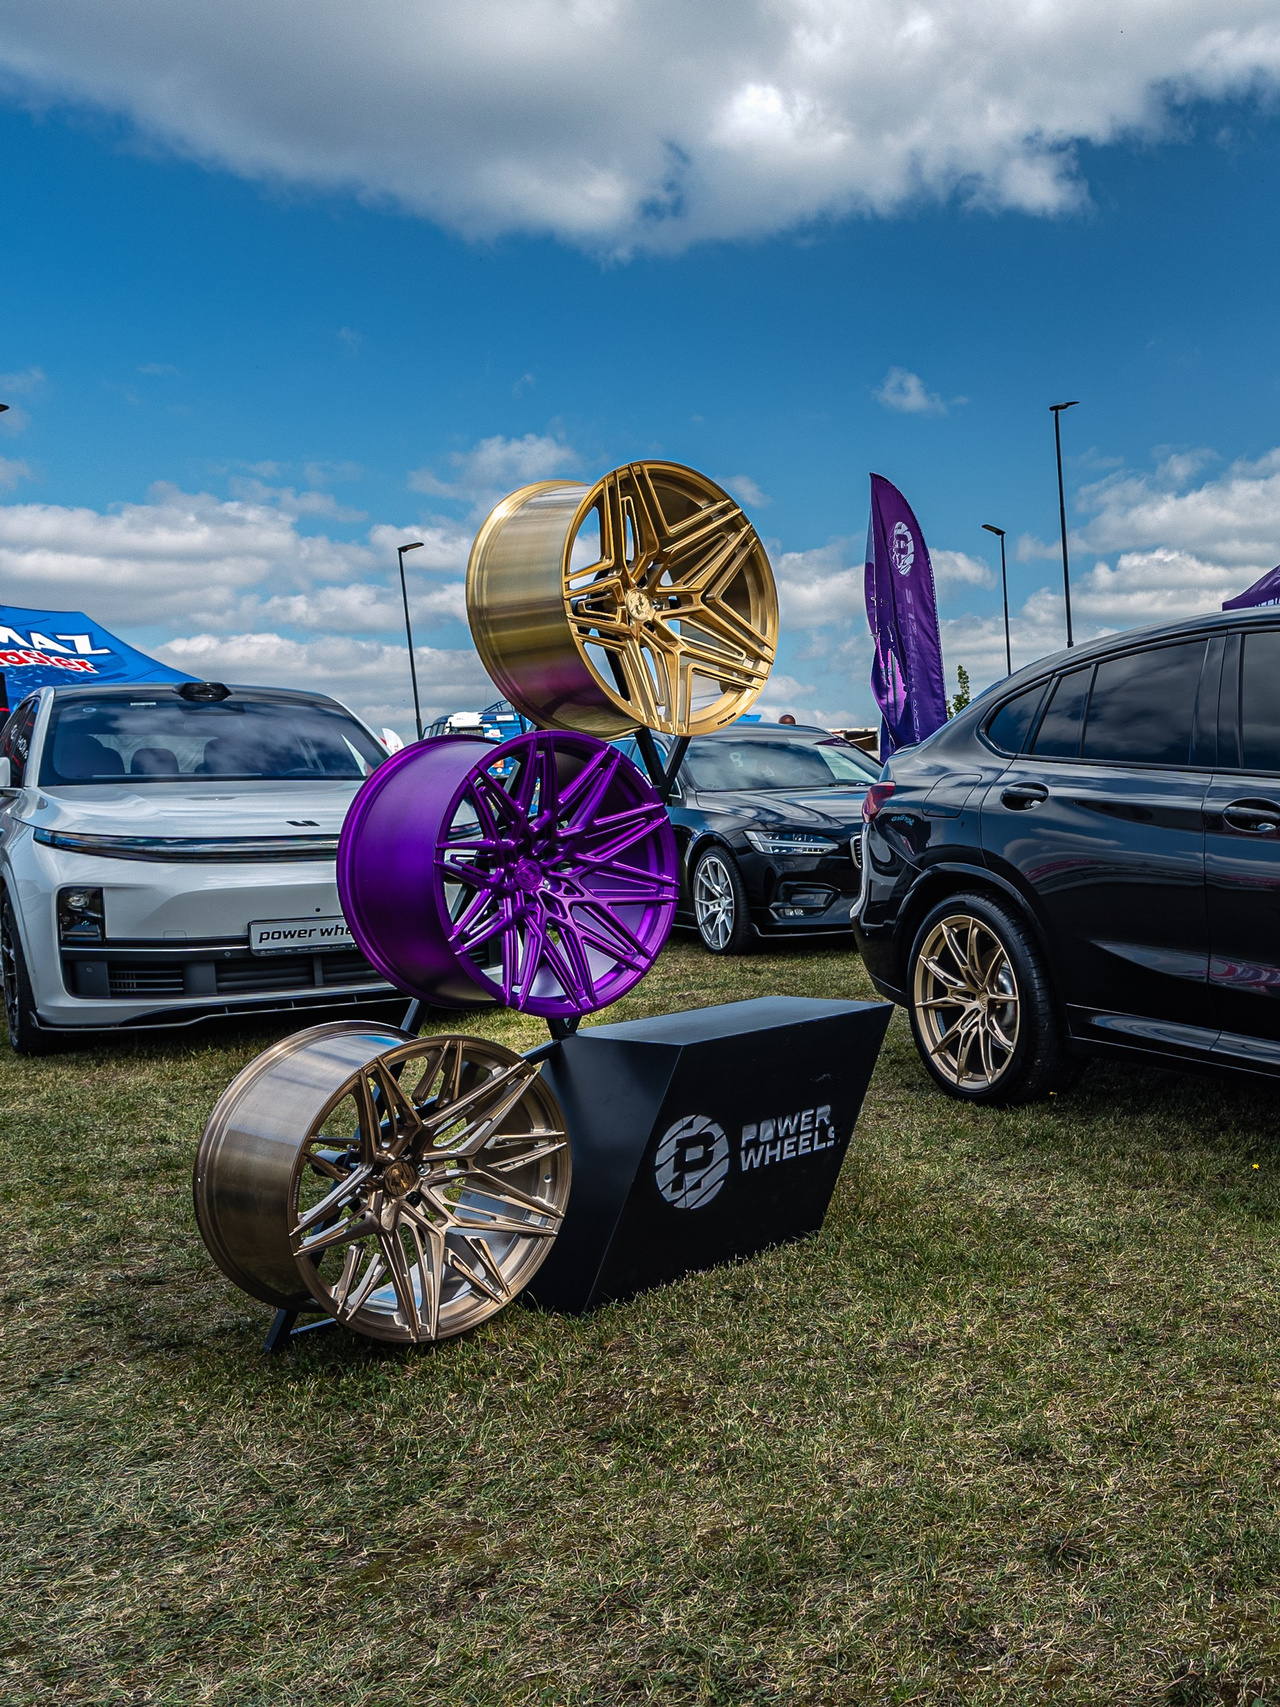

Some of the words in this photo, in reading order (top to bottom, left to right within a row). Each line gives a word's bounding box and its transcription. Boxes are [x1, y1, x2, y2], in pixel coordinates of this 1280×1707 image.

[0, 649, 100, 674] aster
[259, 928, 317, 943] power
[740, 1104, 831, 1148] POWER
